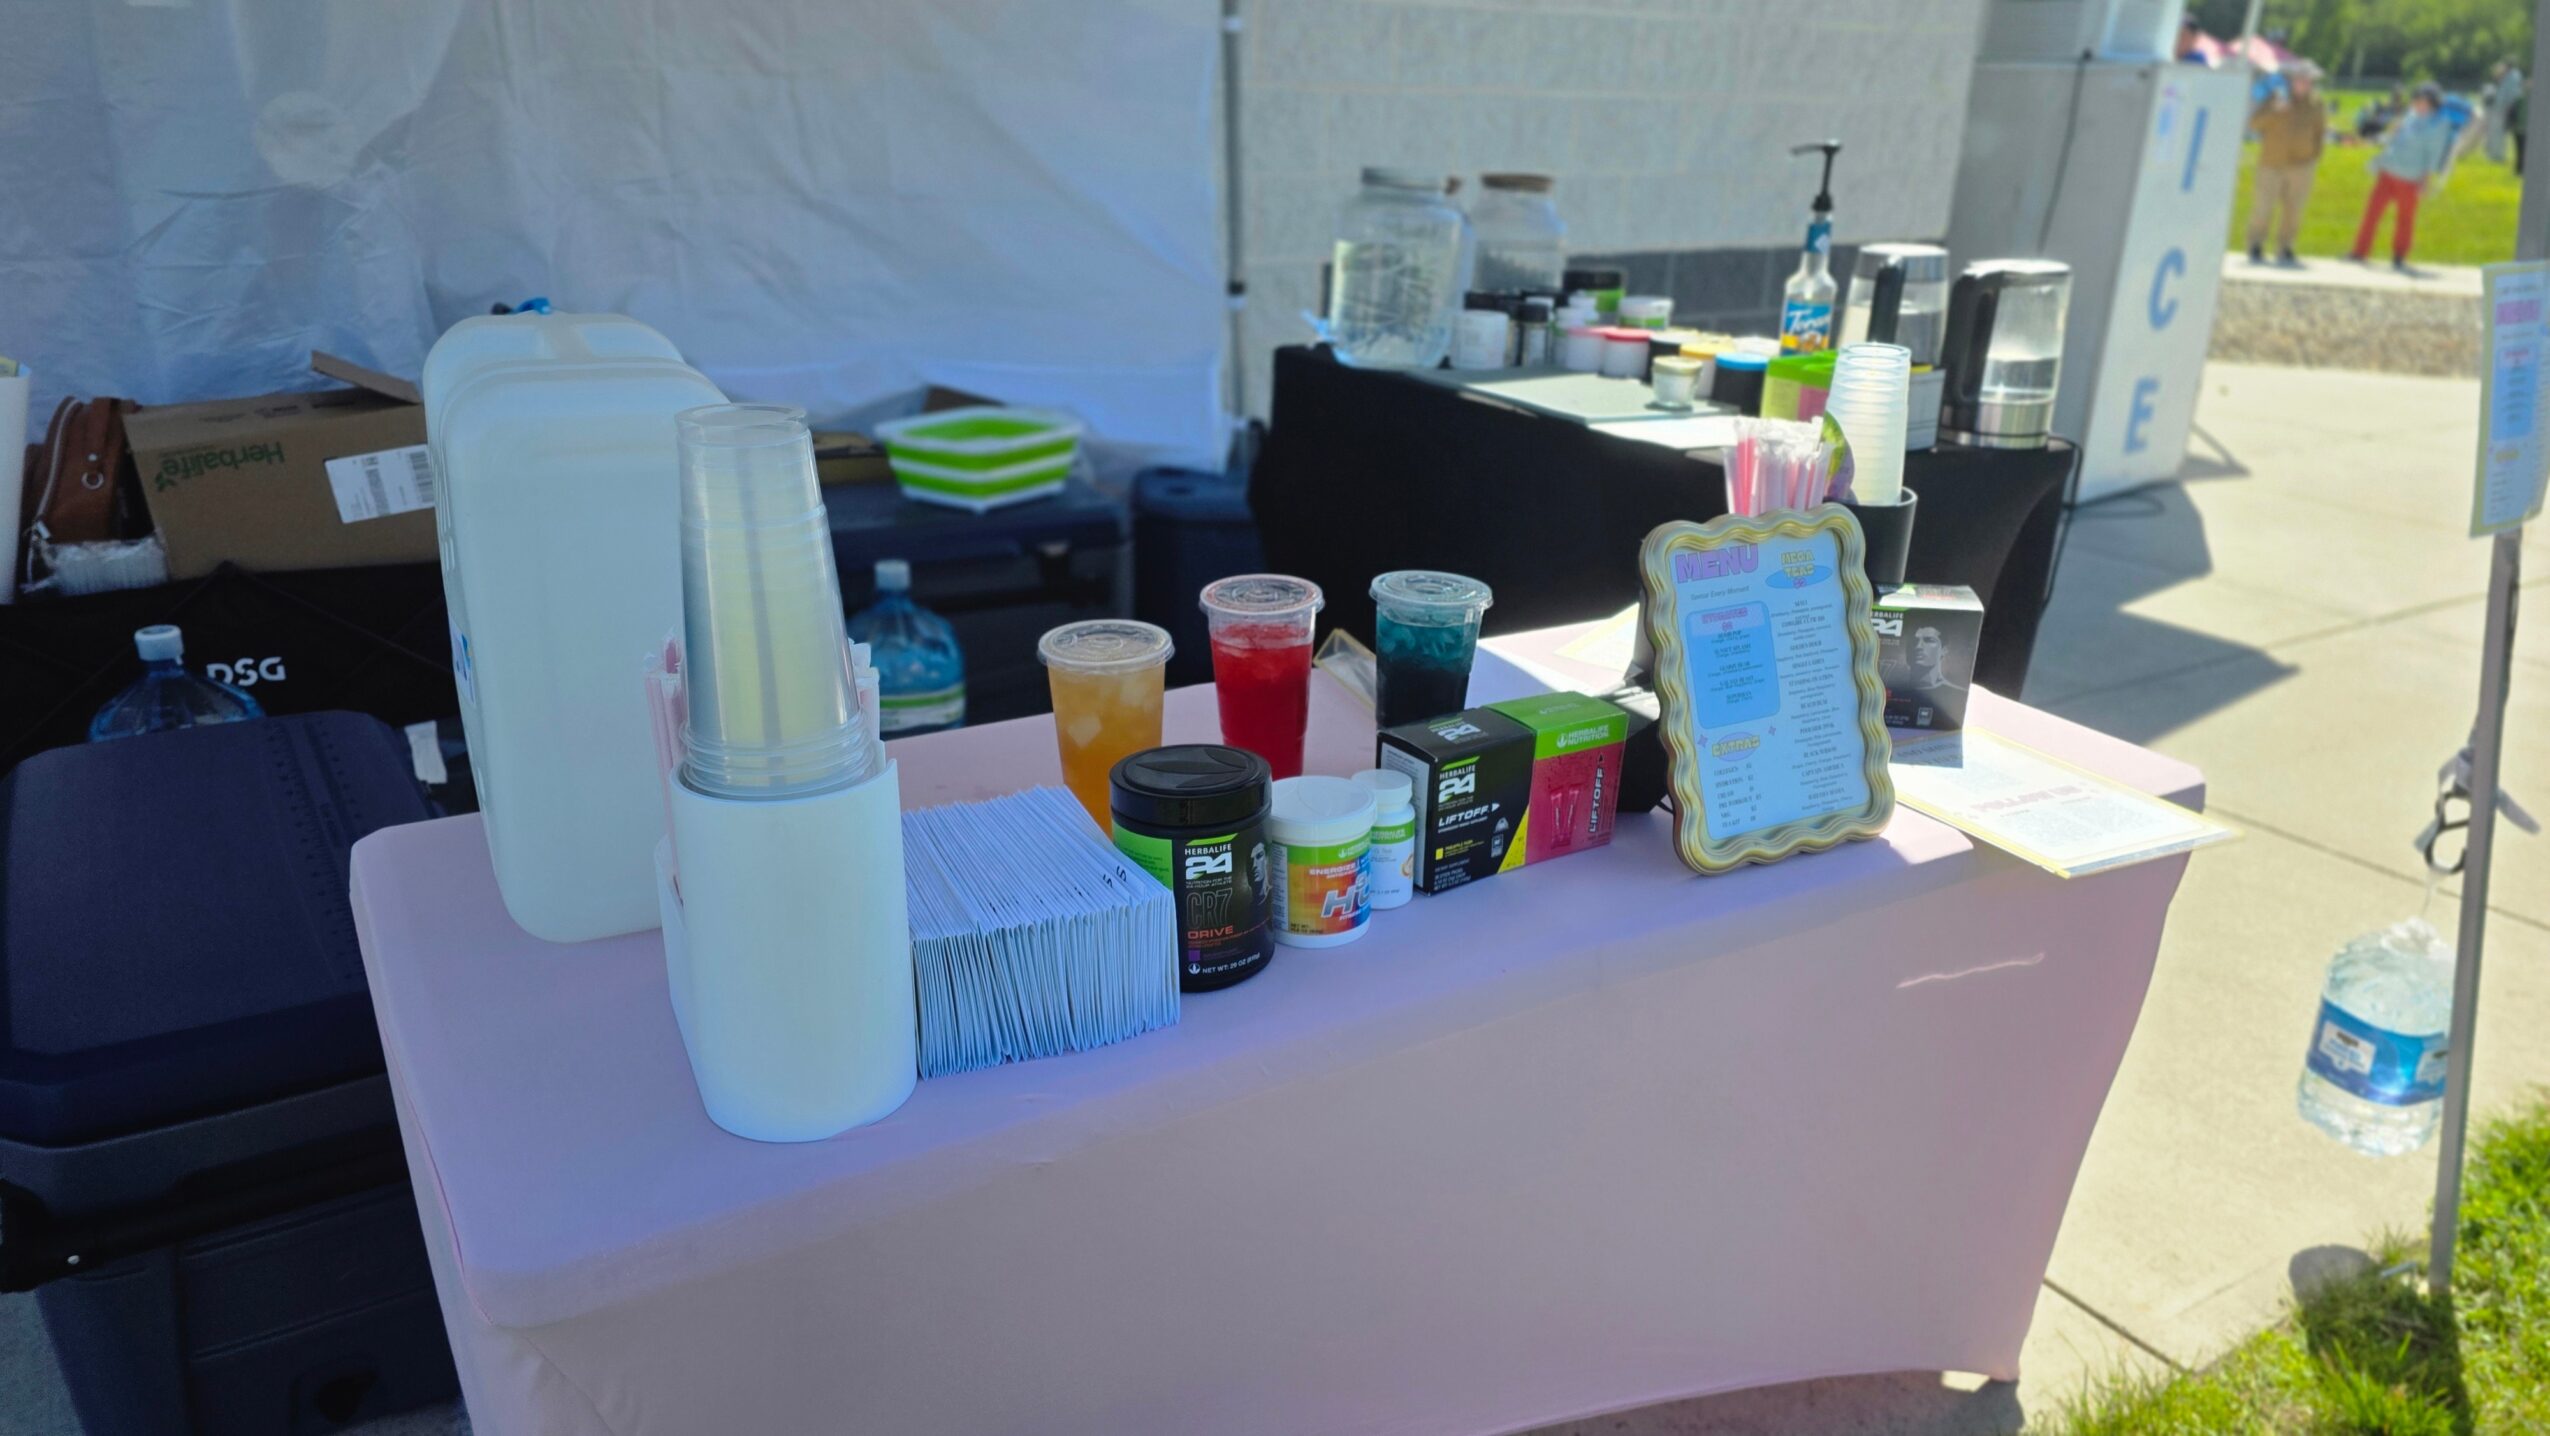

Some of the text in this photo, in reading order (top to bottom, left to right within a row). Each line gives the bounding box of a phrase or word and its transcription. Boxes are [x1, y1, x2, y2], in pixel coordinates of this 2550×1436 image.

[2123, 106, 2209, 455] ICE
[161, 442, 285, 479] Herbalife
[1675, 543, 1759, 584] MENU
[206, 656, 286, 687] DSG
[1439, 764, 1476, 780] HERBALIFE
[1438, 773, 1476, 803] 24
[1589, 767, 1604, 833] LIFTOFF
[1438, 805, 1489, 828] LIFTOFF
[1185, 843, 1233, 856] HERBALIFE
[1185, 852, 1233, 880] 24
[1308, 862, 1356, 876] ENERGIZE
[1187, 887, 1233, 929] CR7
[1187, 925, 1233, 939] DRIVE
[1202, 966, 1216, 974] NET
